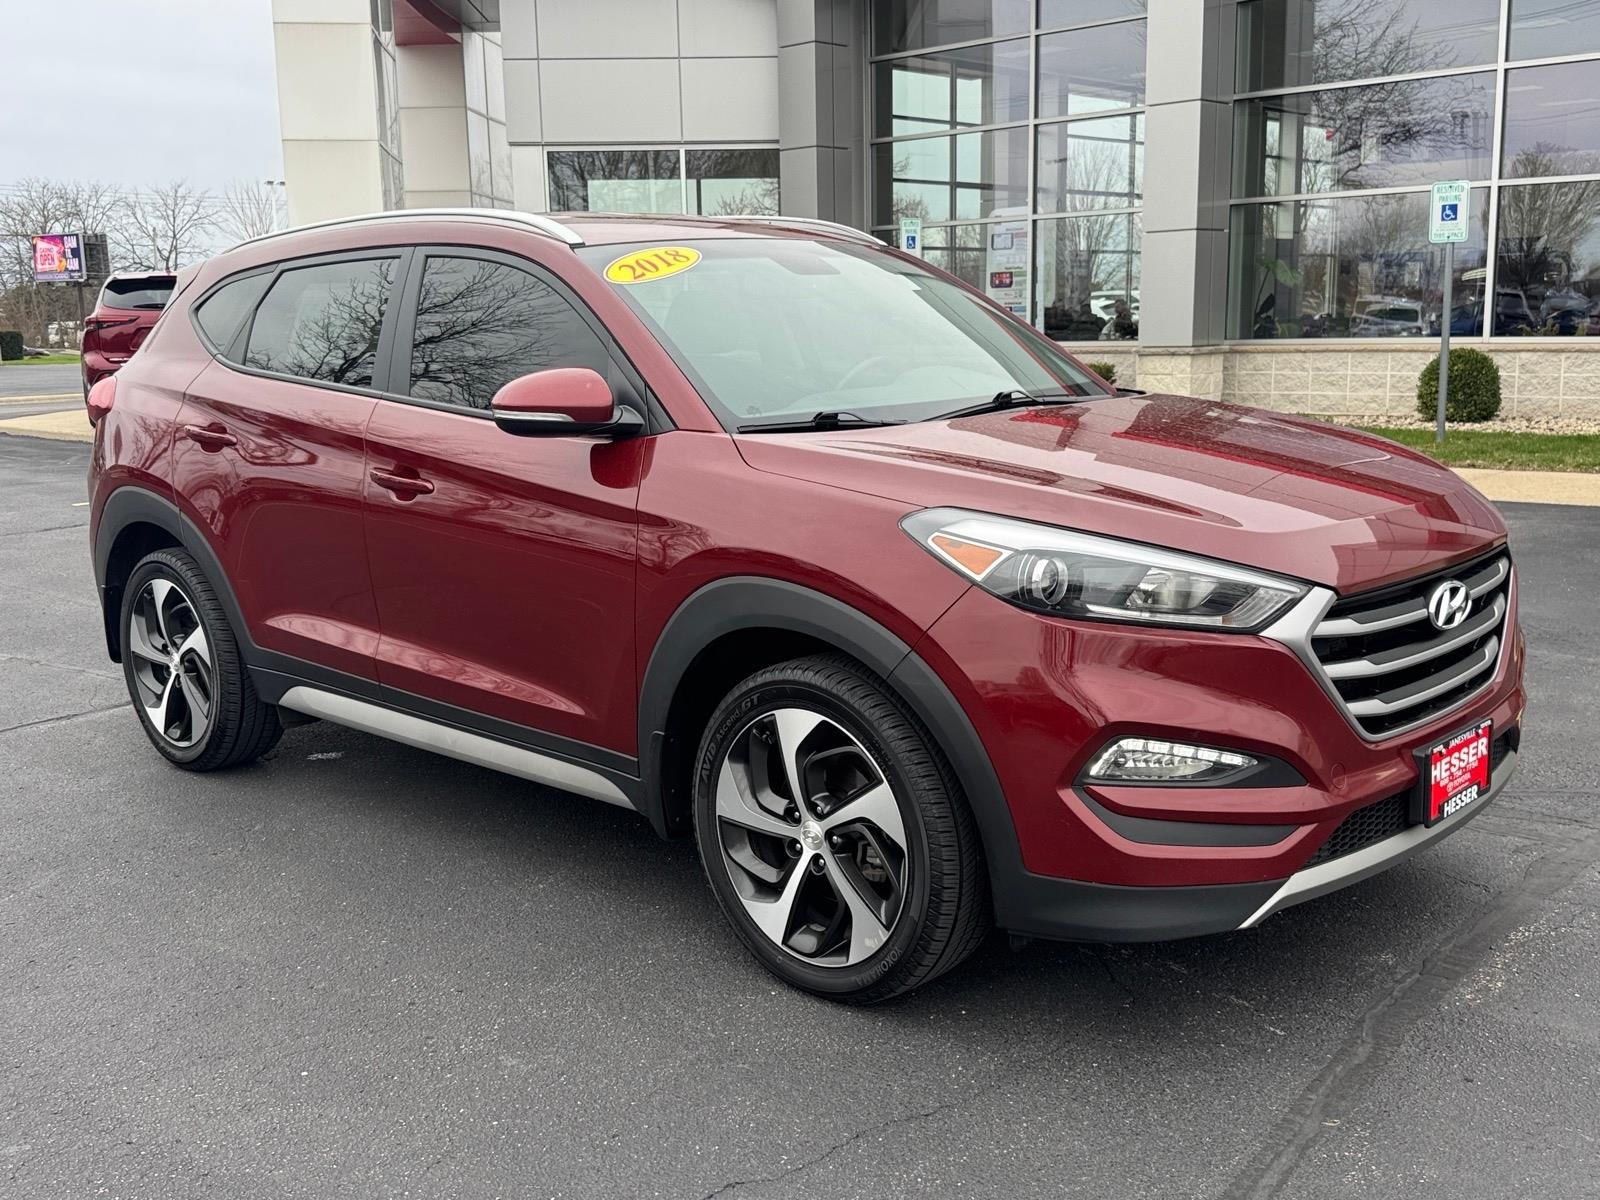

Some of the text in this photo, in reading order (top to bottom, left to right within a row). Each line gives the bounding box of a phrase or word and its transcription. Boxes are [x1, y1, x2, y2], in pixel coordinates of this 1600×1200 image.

[39, 253, 56, 266] OPEN
[618, 249, 690, 280] 2018
[701, 742, 717, 783] AVID
[741, 692, 761, 712] GT
[1448, 728, 1477, 748] JANESVILLE
[1431, 737, 1489, 785] HESSER
[1443, 784, 1478, 818] HESSER
[854, 946, 903, 987] YOKOHAMA
